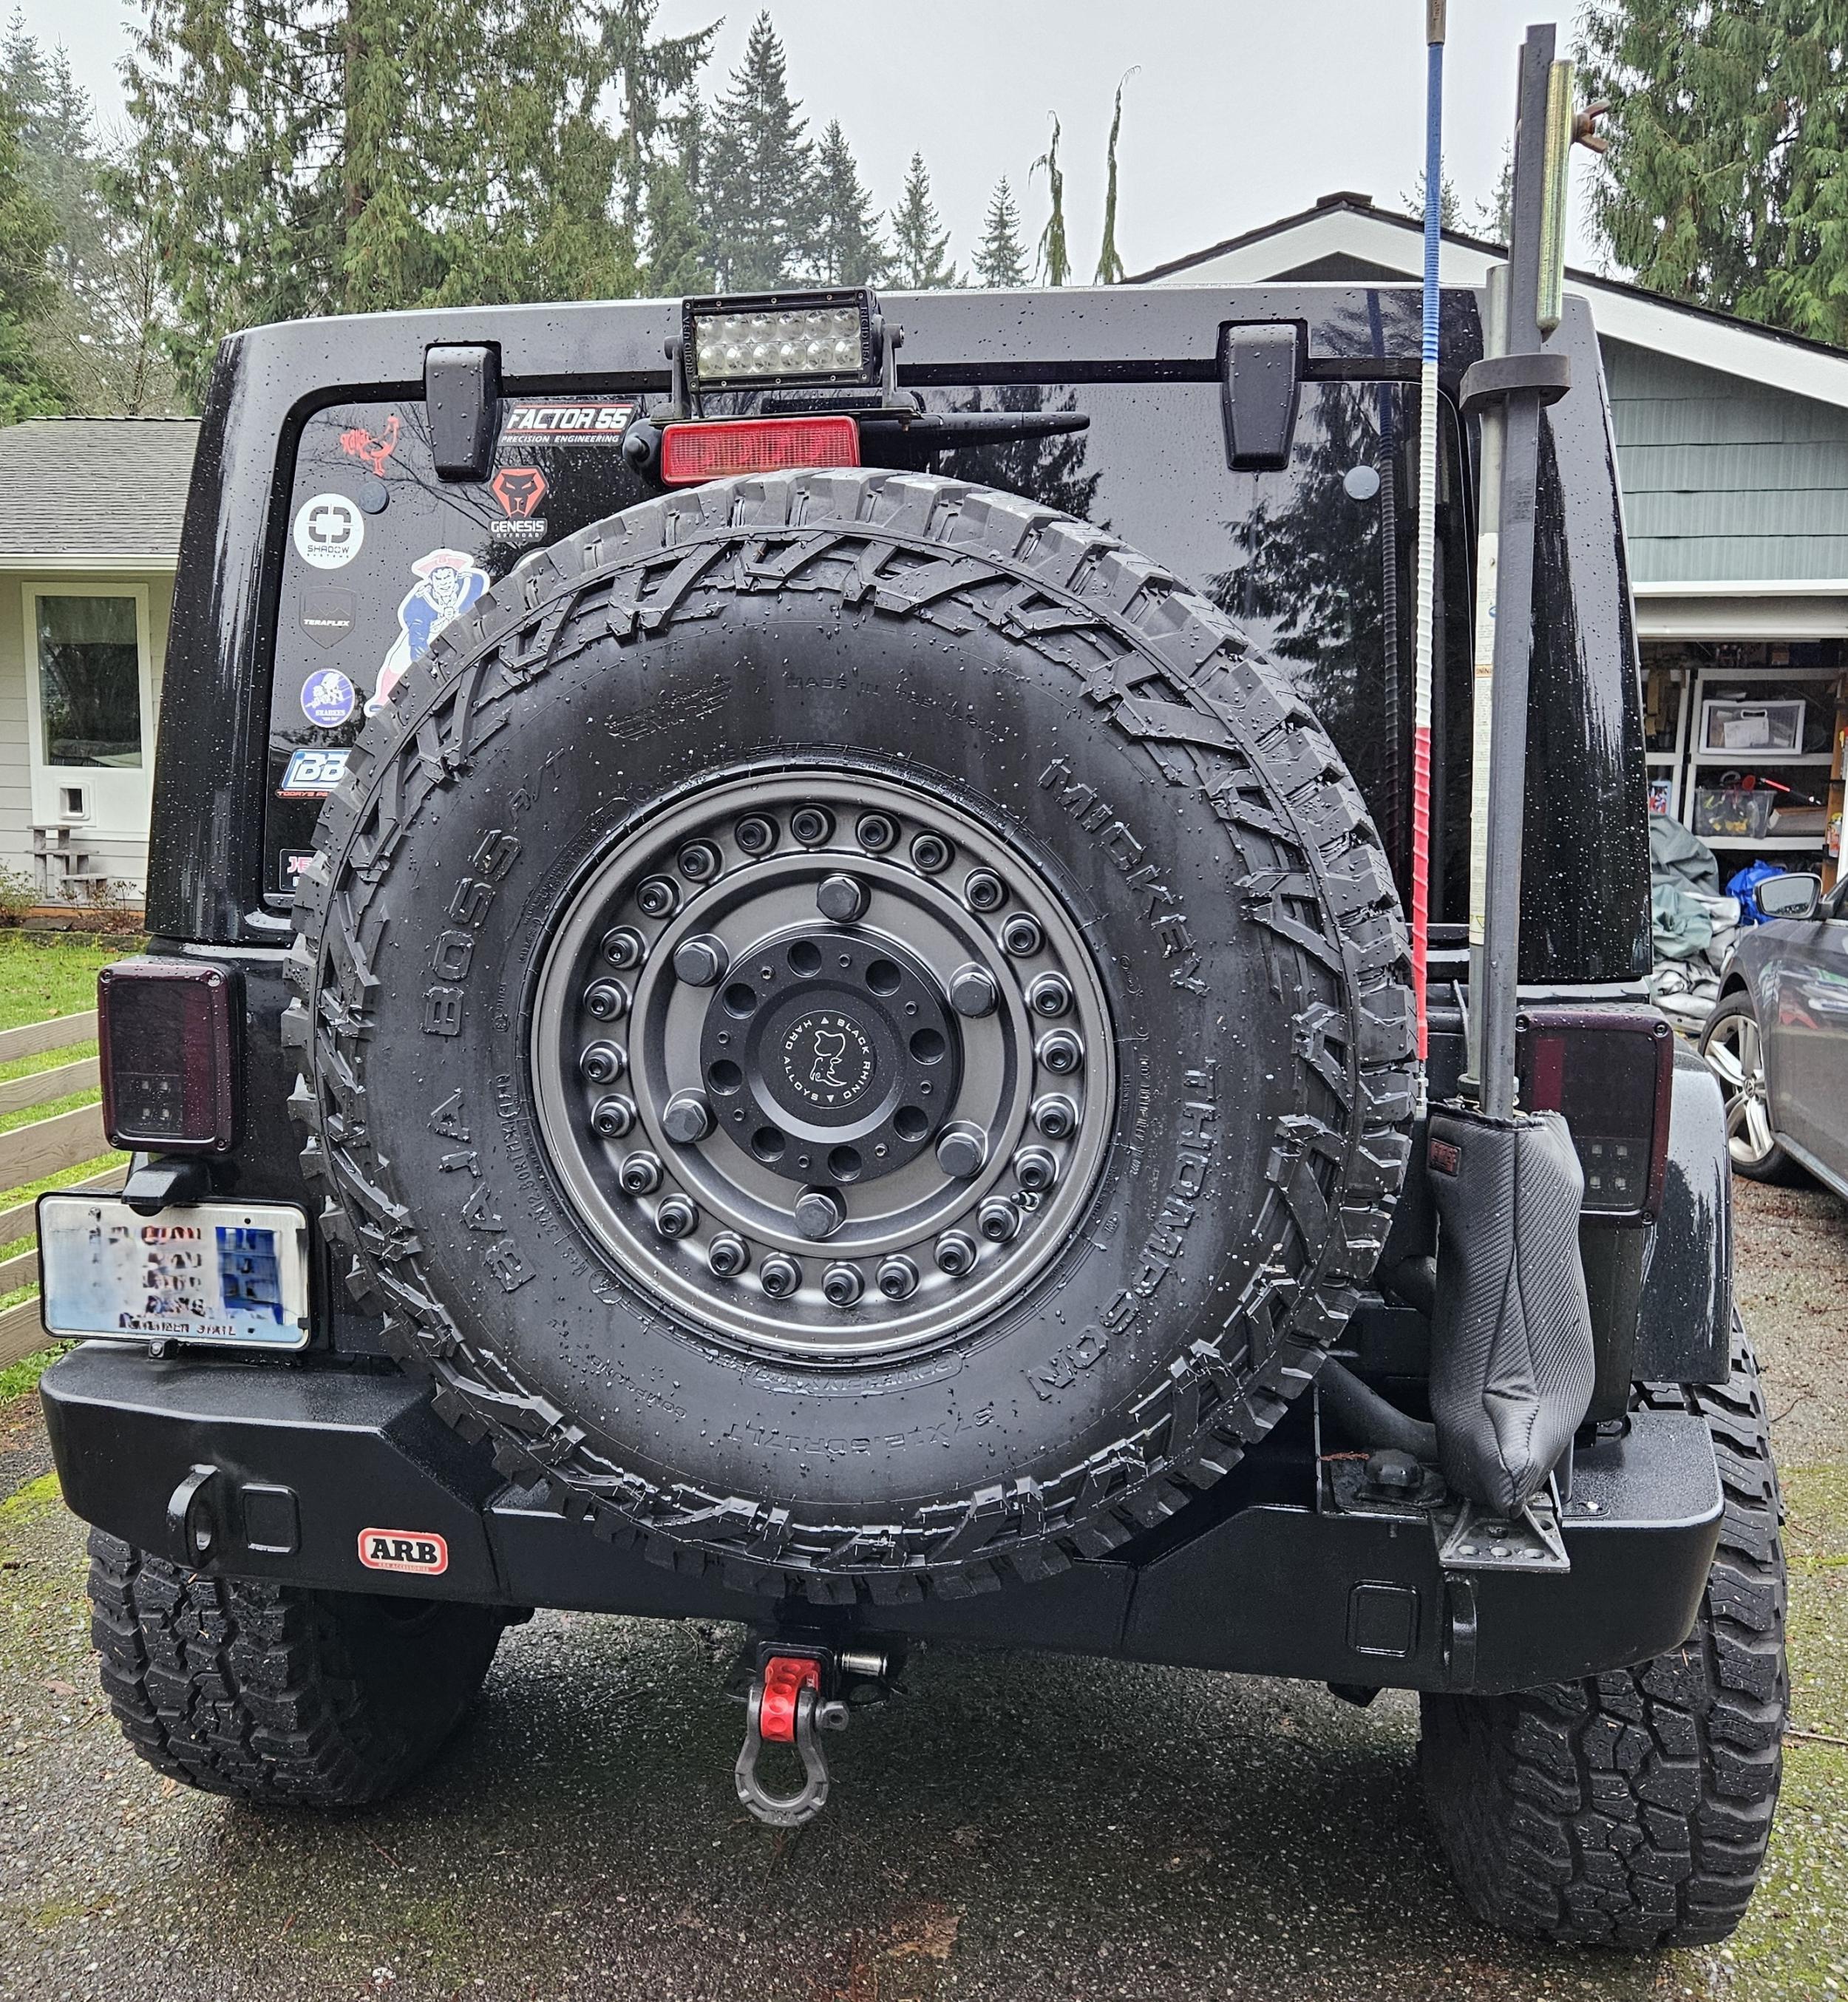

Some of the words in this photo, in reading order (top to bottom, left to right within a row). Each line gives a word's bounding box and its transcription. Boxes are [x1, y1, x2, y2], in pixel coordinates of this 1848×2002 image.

[682, 316, 691, 339] USA
[860, 307, 869, 339] RIGID
[684, 342, 693, 376] RIGID
[862, 342, 870, 366] USA
[506, 408, 595, 430] FACTOR
[595, 407, 632, 430] 55
[501, 435, 550, 444] PRECISION
[554, 435, 619, 444] ENGINEERING
[491, 520, 545, 533] GENESIS
[307, 545, 350, 554] SHADOW
[303, 619, 350, 628] TERAFLEX
[1037, 759, 1211, 997] MICKEY
[421, 827, 523, 1036] BOSS
[785, 1019, 812, 1050] HARD
[837, 1018, 870, 1055] BLACK
[784, 1056, 819, 1101] ALLOYS
[843, 1061, 871, 1099] RHINO
[427, 1087, 537, 1293] BAJA
[1026, 1057, 1218, 1401] THOMPSON
[370, 1538, 438, 1564] ARB
